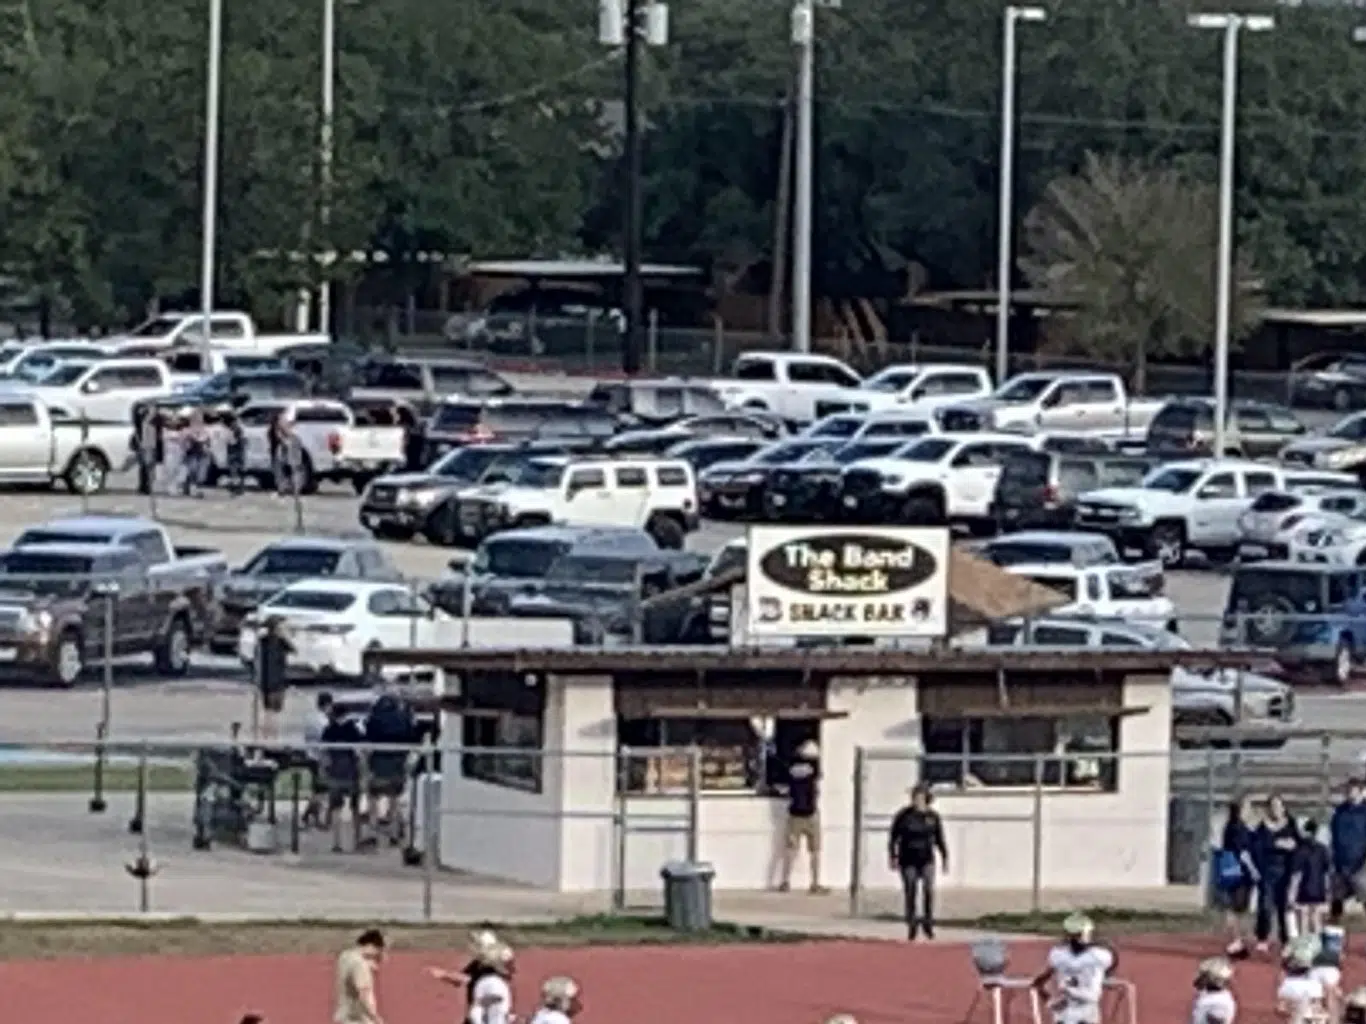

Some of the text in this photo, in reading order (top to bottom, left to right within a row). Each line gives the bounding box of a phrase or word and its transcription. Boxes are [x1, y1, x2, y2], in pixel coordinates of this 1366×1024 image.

[784, 543, 914, 568] The Band
[808, 569, 889, 592] Shack
[789, 603, 857, 622] SNACK
[863, 603, 905, 622] BAR
